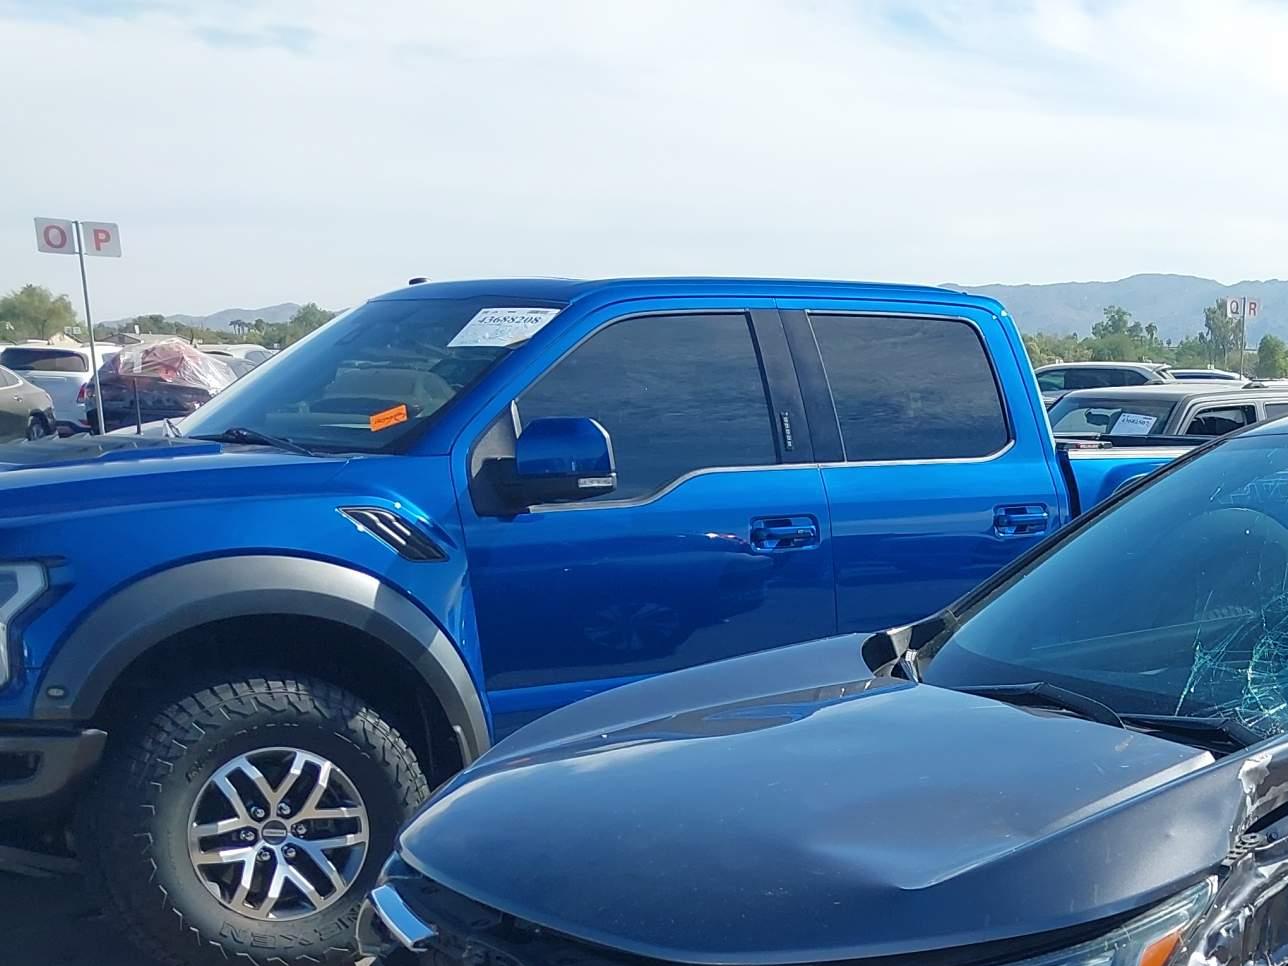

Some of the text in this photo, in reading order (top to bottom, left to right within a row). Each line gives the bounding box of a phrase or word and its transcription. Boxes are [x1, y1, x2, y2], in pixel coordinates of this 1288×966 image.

[43, 225, 67, 248] O
[93, 229, 111, 251] P
[1230, 300, 1240, 315] Q
[1248, 302, 1257, 317] R
